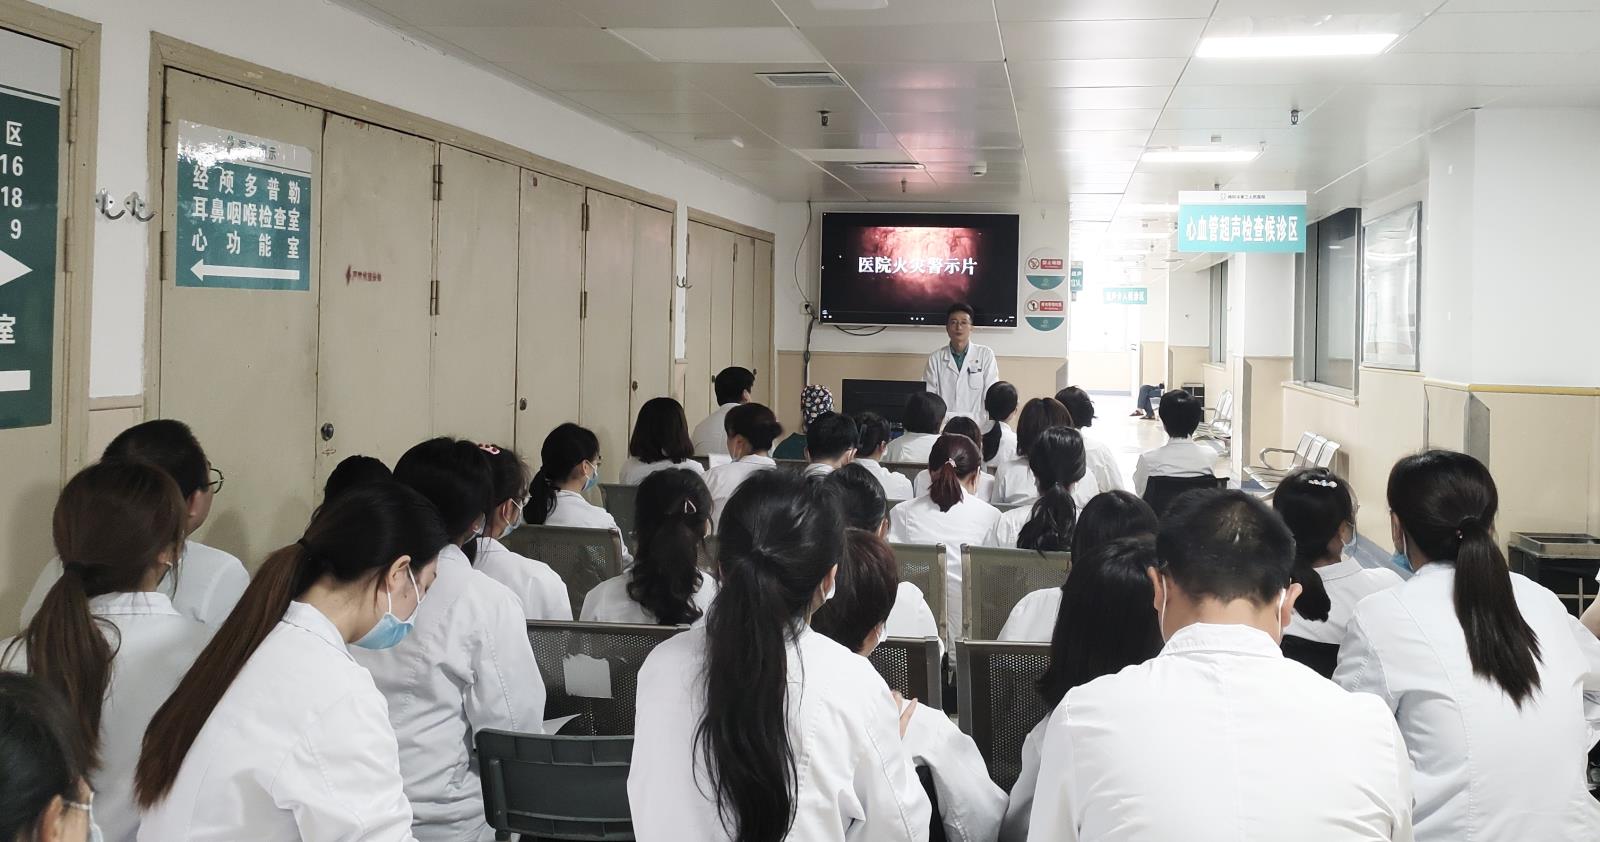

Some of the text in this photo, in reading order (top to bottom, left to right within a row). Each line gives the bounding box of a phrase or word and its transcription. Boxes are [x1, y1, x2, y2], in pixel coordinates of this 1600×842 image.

[6, 121, 23, 146] 区
[0, 153, 23, 176] 16
[0, 186, 23, 208] 18
[193, 165, 301, 204] 经颅多普勒
[192, 196, 300, 231] 耳鼻咽喉检查室
[10, 219, 22, 239] 9
[1186, 214, 1298, 242] 心血管超声检查候诊区
[191, 227, 299, 259] 心功能室
[858, 255, 978, 275] 医院火灾警示片
